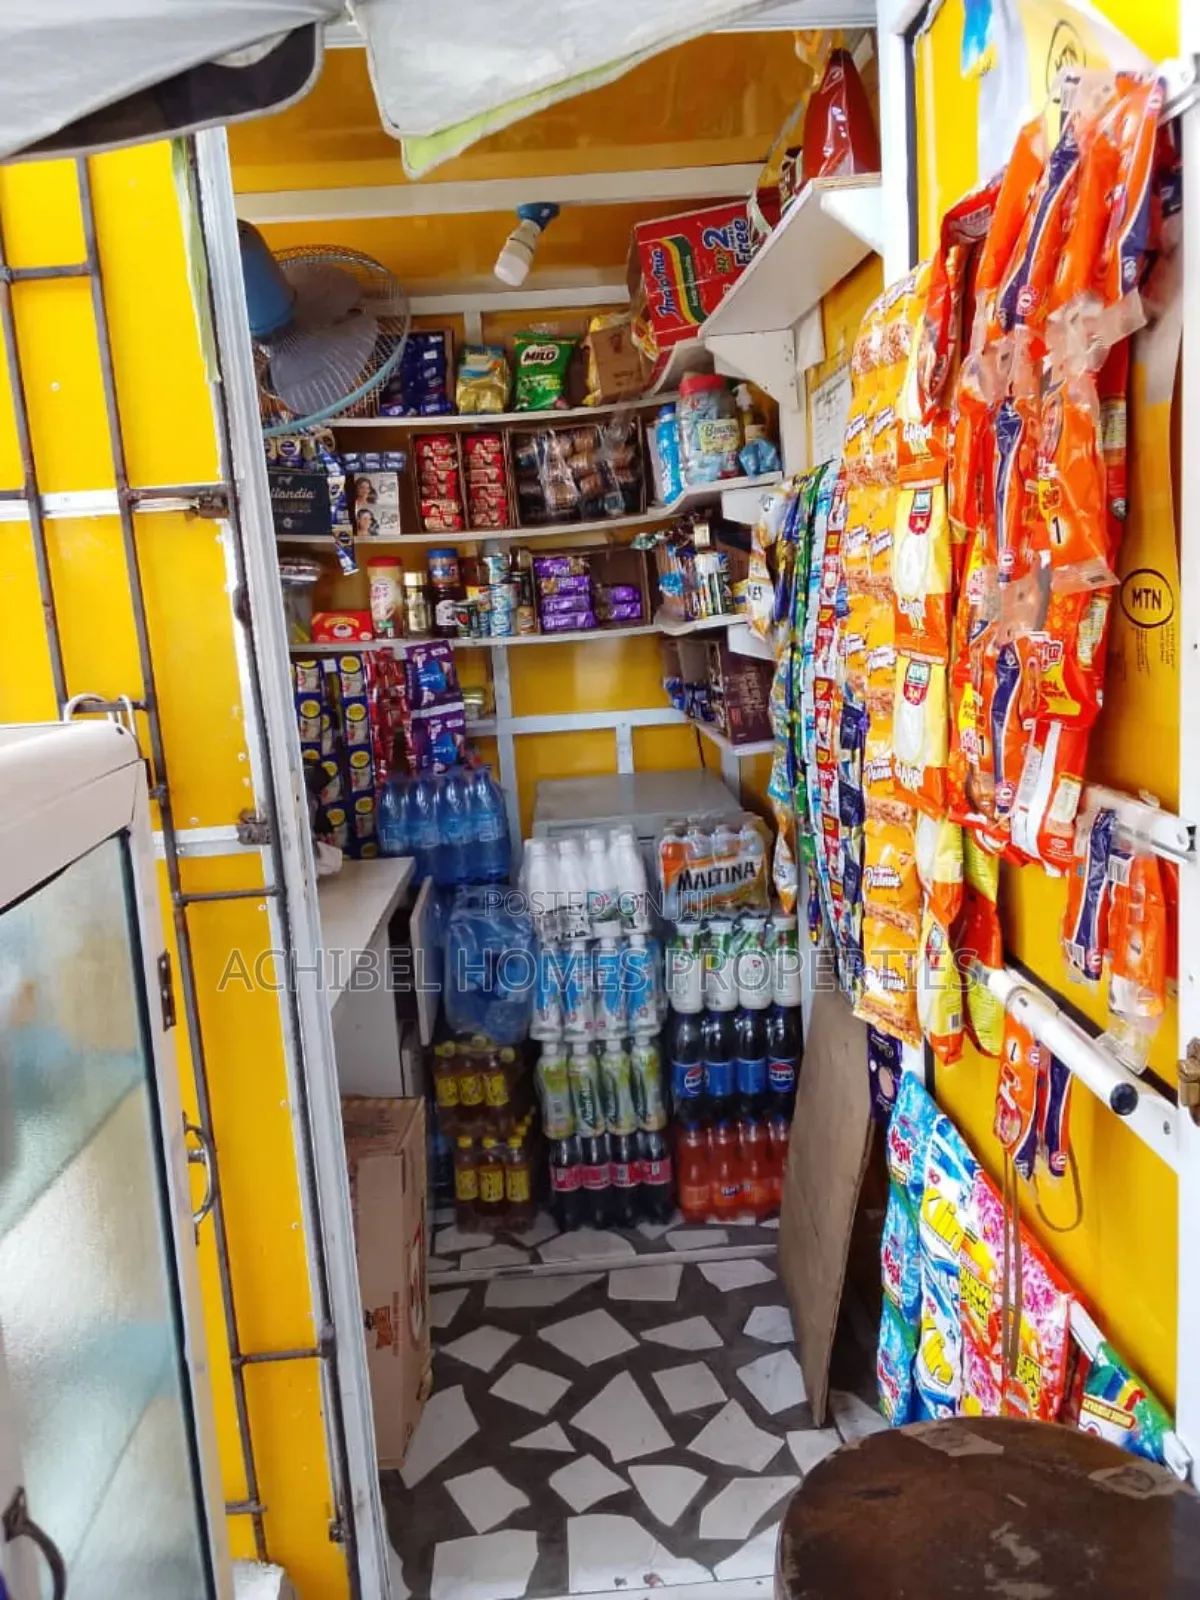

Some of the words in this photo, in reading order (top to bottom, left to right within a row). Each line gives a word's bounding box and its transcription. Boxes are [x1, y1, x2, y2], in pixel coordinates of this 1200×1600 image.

[523, 348, 557, 362] MILO
[1132, 588, 1161, 609] MTN
[677, 861, 757, 893] MALTINA
